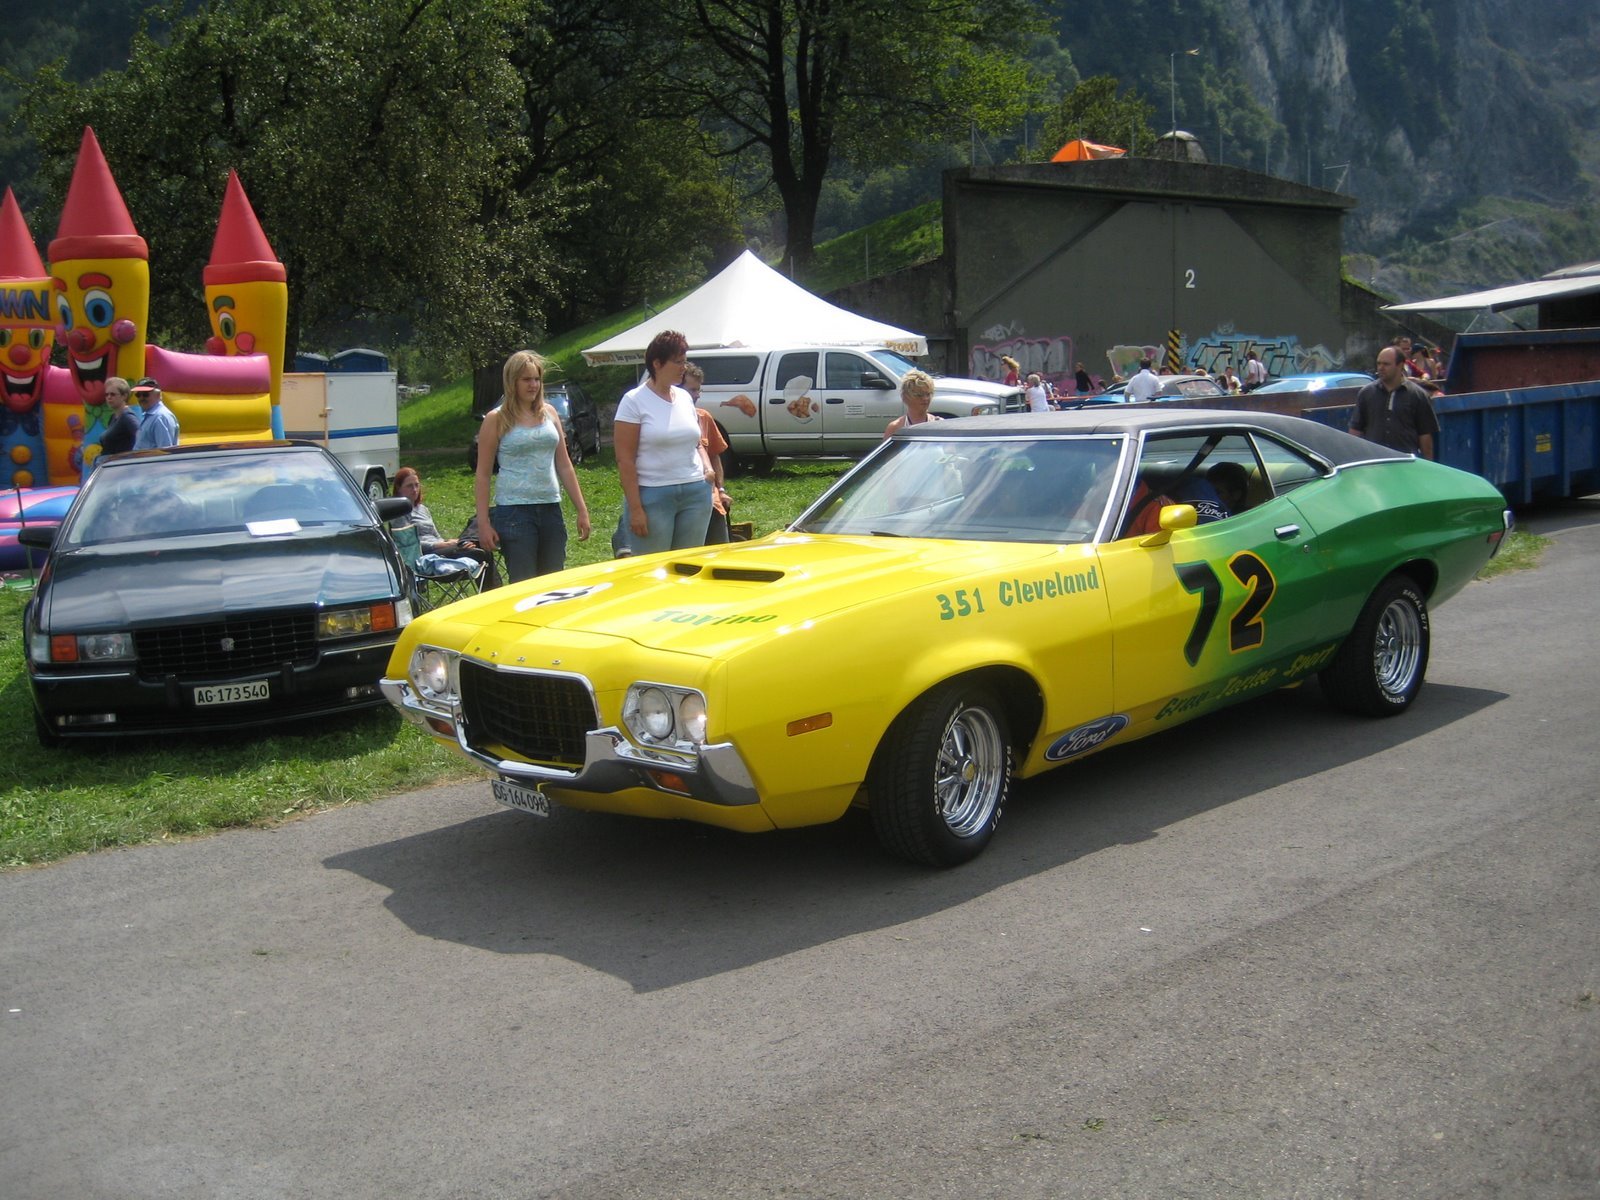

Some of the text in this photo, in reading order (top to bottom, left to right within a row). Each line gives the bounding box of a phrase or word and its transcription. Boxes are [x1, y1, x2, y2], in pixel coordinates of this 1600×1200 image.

[1185, 269, 1195, 289] 2
[1197, 502, 1229, 519] Ford
[936, 565, 1099, 621] 351 Cleveland
[1173, 549, 1276, 668] 72
[1283, 644, 1338, 678] Sport
[1057, 720, 1117, 757] Ford
[1001, 745, 1012, 804] RADIAL
